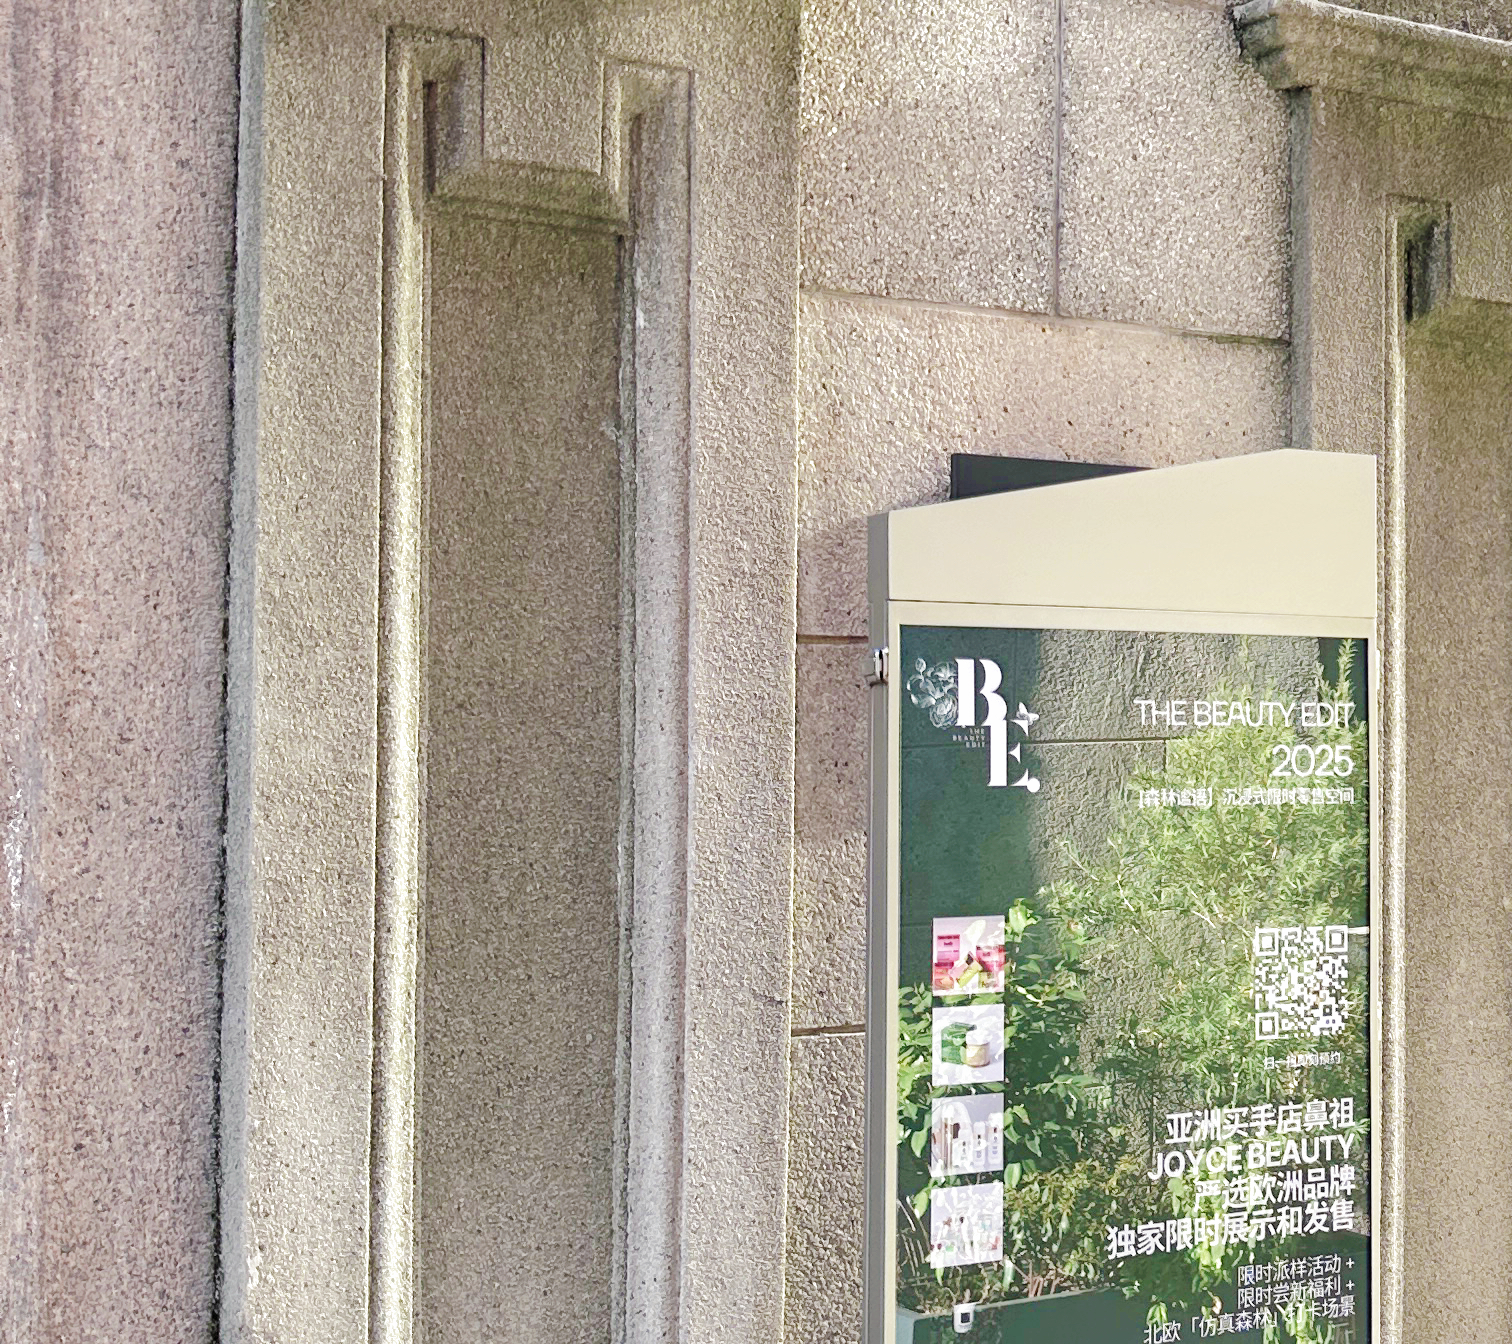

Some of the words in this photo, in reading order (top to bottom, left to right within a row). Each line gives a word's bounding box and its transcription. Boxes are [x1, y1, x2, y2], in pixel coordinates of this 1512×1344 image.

[1133, 700, 1187, 727] THE
[1193, 700, 1296, 728] BEAUTY
[1301, 701, 1356, 728] EDIT
[1271, 744, 1355, 777] 2025
[1164, 1097, 1355, 1144] 亚洲买手店鼻祖
[1148, 1142, 1242, 1180] JOYCE
[1248, 1134, 1355, 1169] BEAUTY
[1193, 1164, 1355, 1213] 严选欧洲品牌
[1107, 1200, 1355, 1260] 独家限时展示和发售
